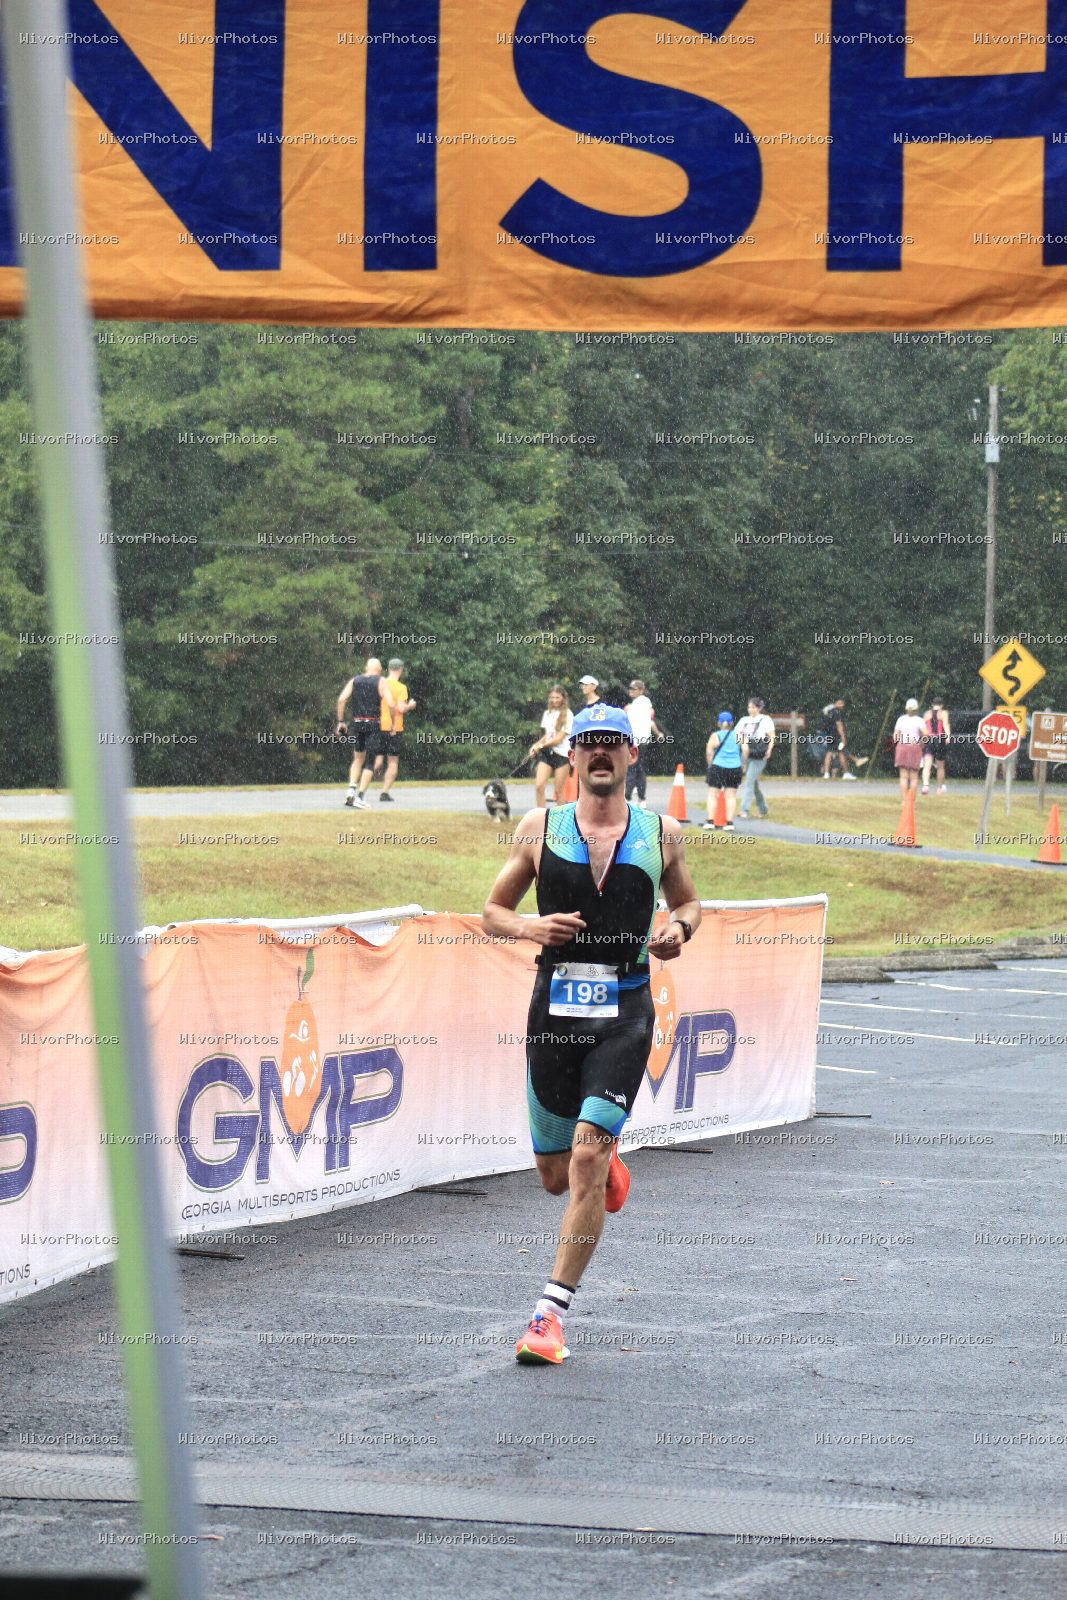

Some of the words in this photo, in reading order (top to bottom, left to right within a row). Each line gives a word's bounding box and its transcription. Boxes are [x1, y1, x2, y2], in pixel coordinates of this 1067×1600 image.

[982, 724, 1018, 745] STOP
[562, 982, 608, 1004] 198
[176, 1044, 404, 1192] GMP
[668, 1114, 730, 1132] PRODUCTIONS
[237, 1189, 318, 1211] MULTISPORTS
[321, 1169, 401, 1201] PRODUCTIONS
